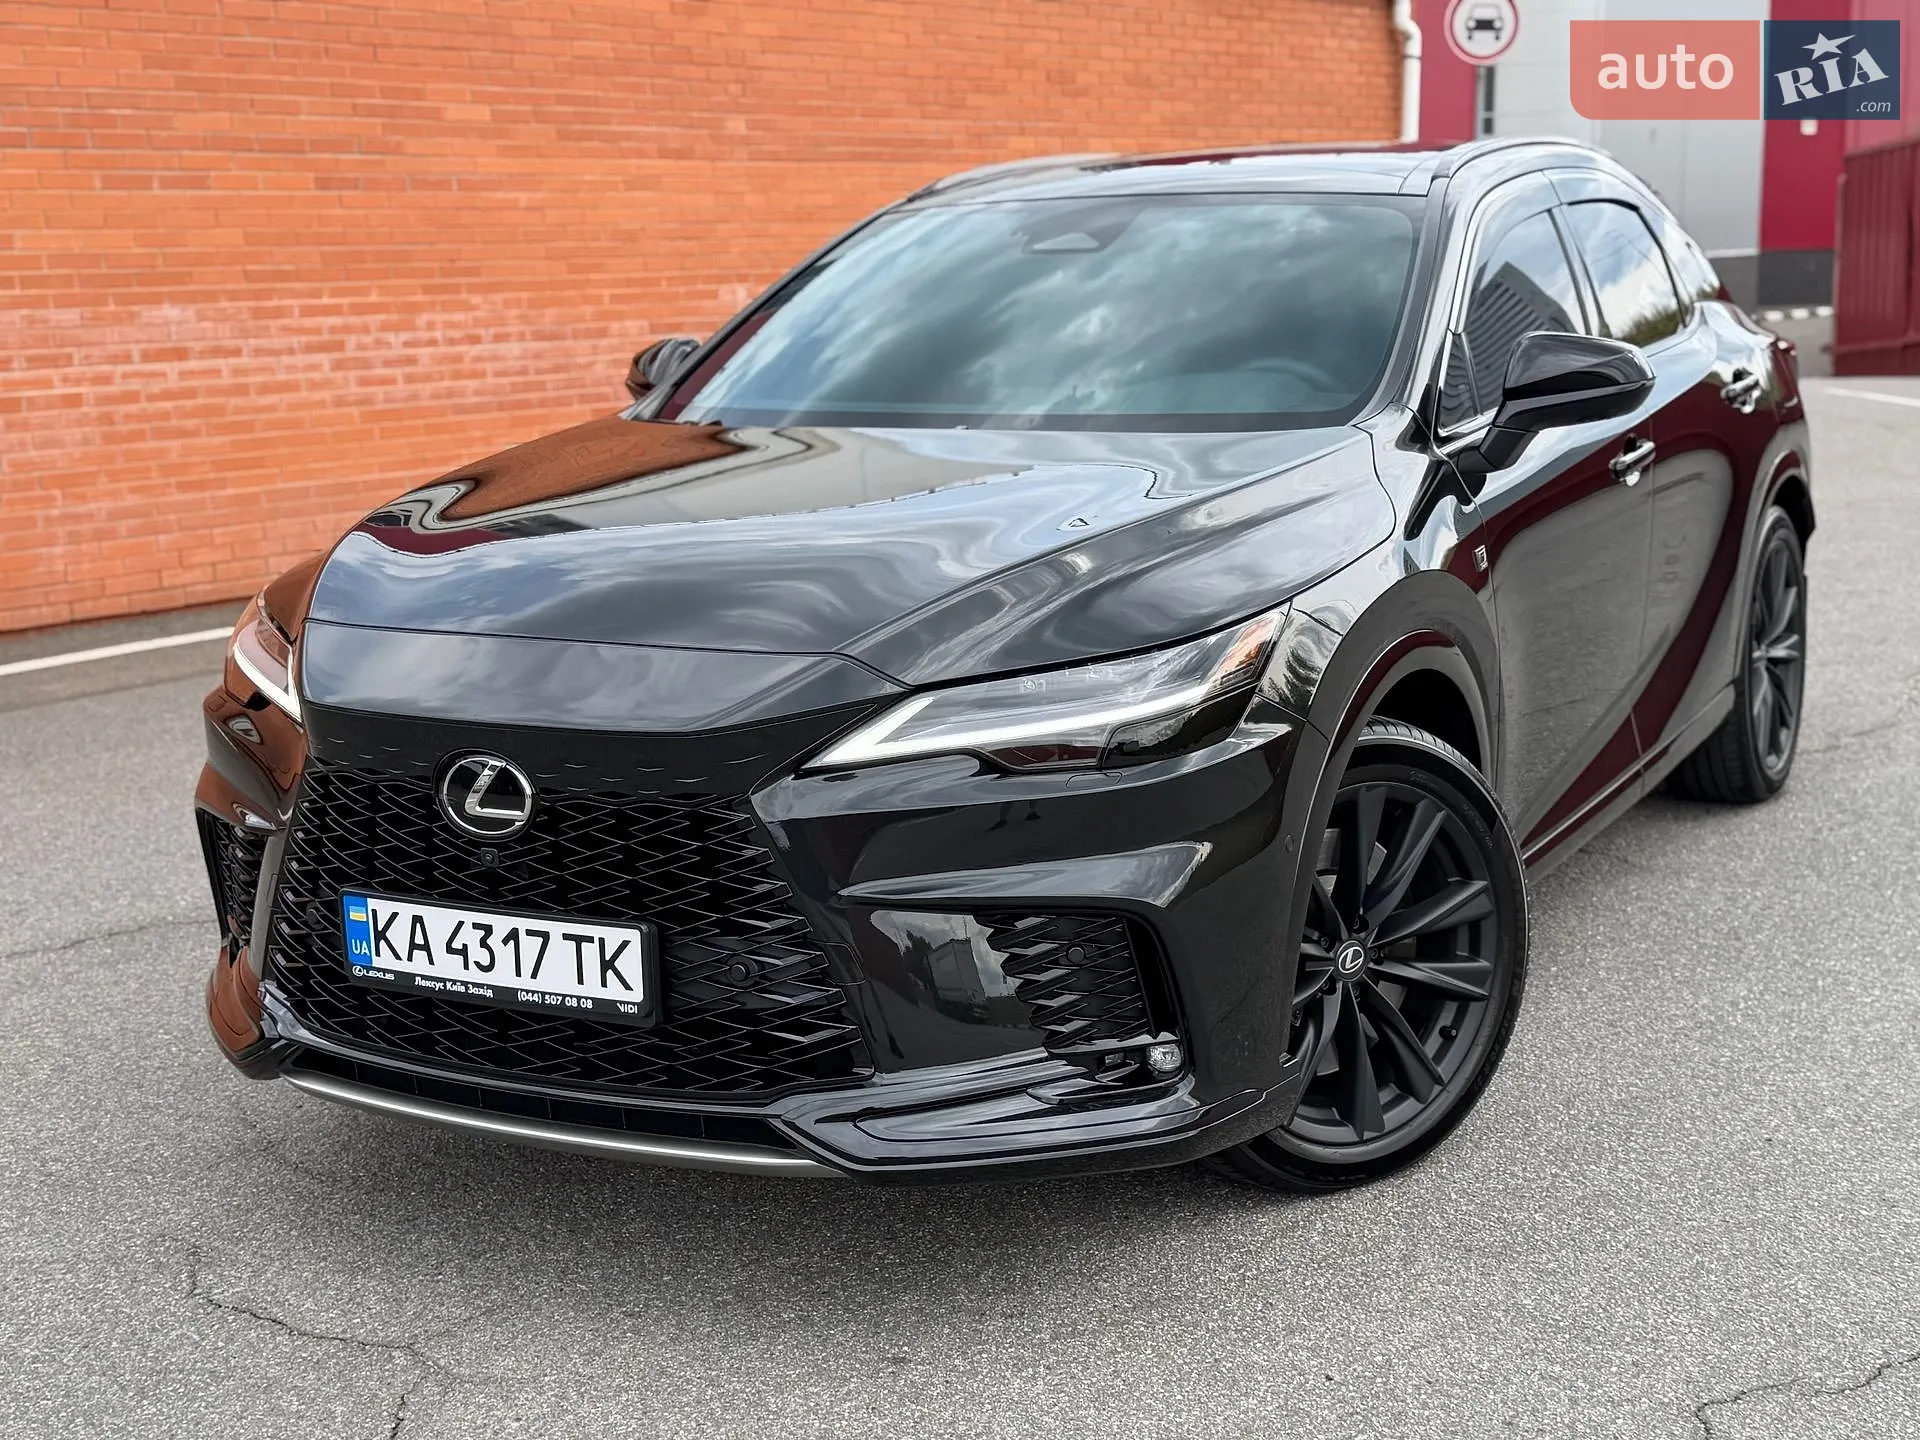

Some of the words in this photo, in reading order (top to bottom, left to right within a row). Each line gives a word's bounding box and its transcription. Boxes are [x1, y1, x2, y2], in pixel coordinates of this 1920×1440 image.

[352, 940, 370, 956] UA
[371, 908, 435, 966] KA
[445, 920, 551, 980] 4317
[562, 932, 634, 992] TK
[414, 976, 445, 991] Лексус
[446, 981, 466, 993] Київ
[467, 985, 494, 998] Захід
[517, 990, 542, 1004] (044)
[545, 994, 562, 1006] 507
[565, 996, 578, 1008] 08
[580, 999, 593, 1010] 08
[616, 1002, 638, 1014] VIDI
